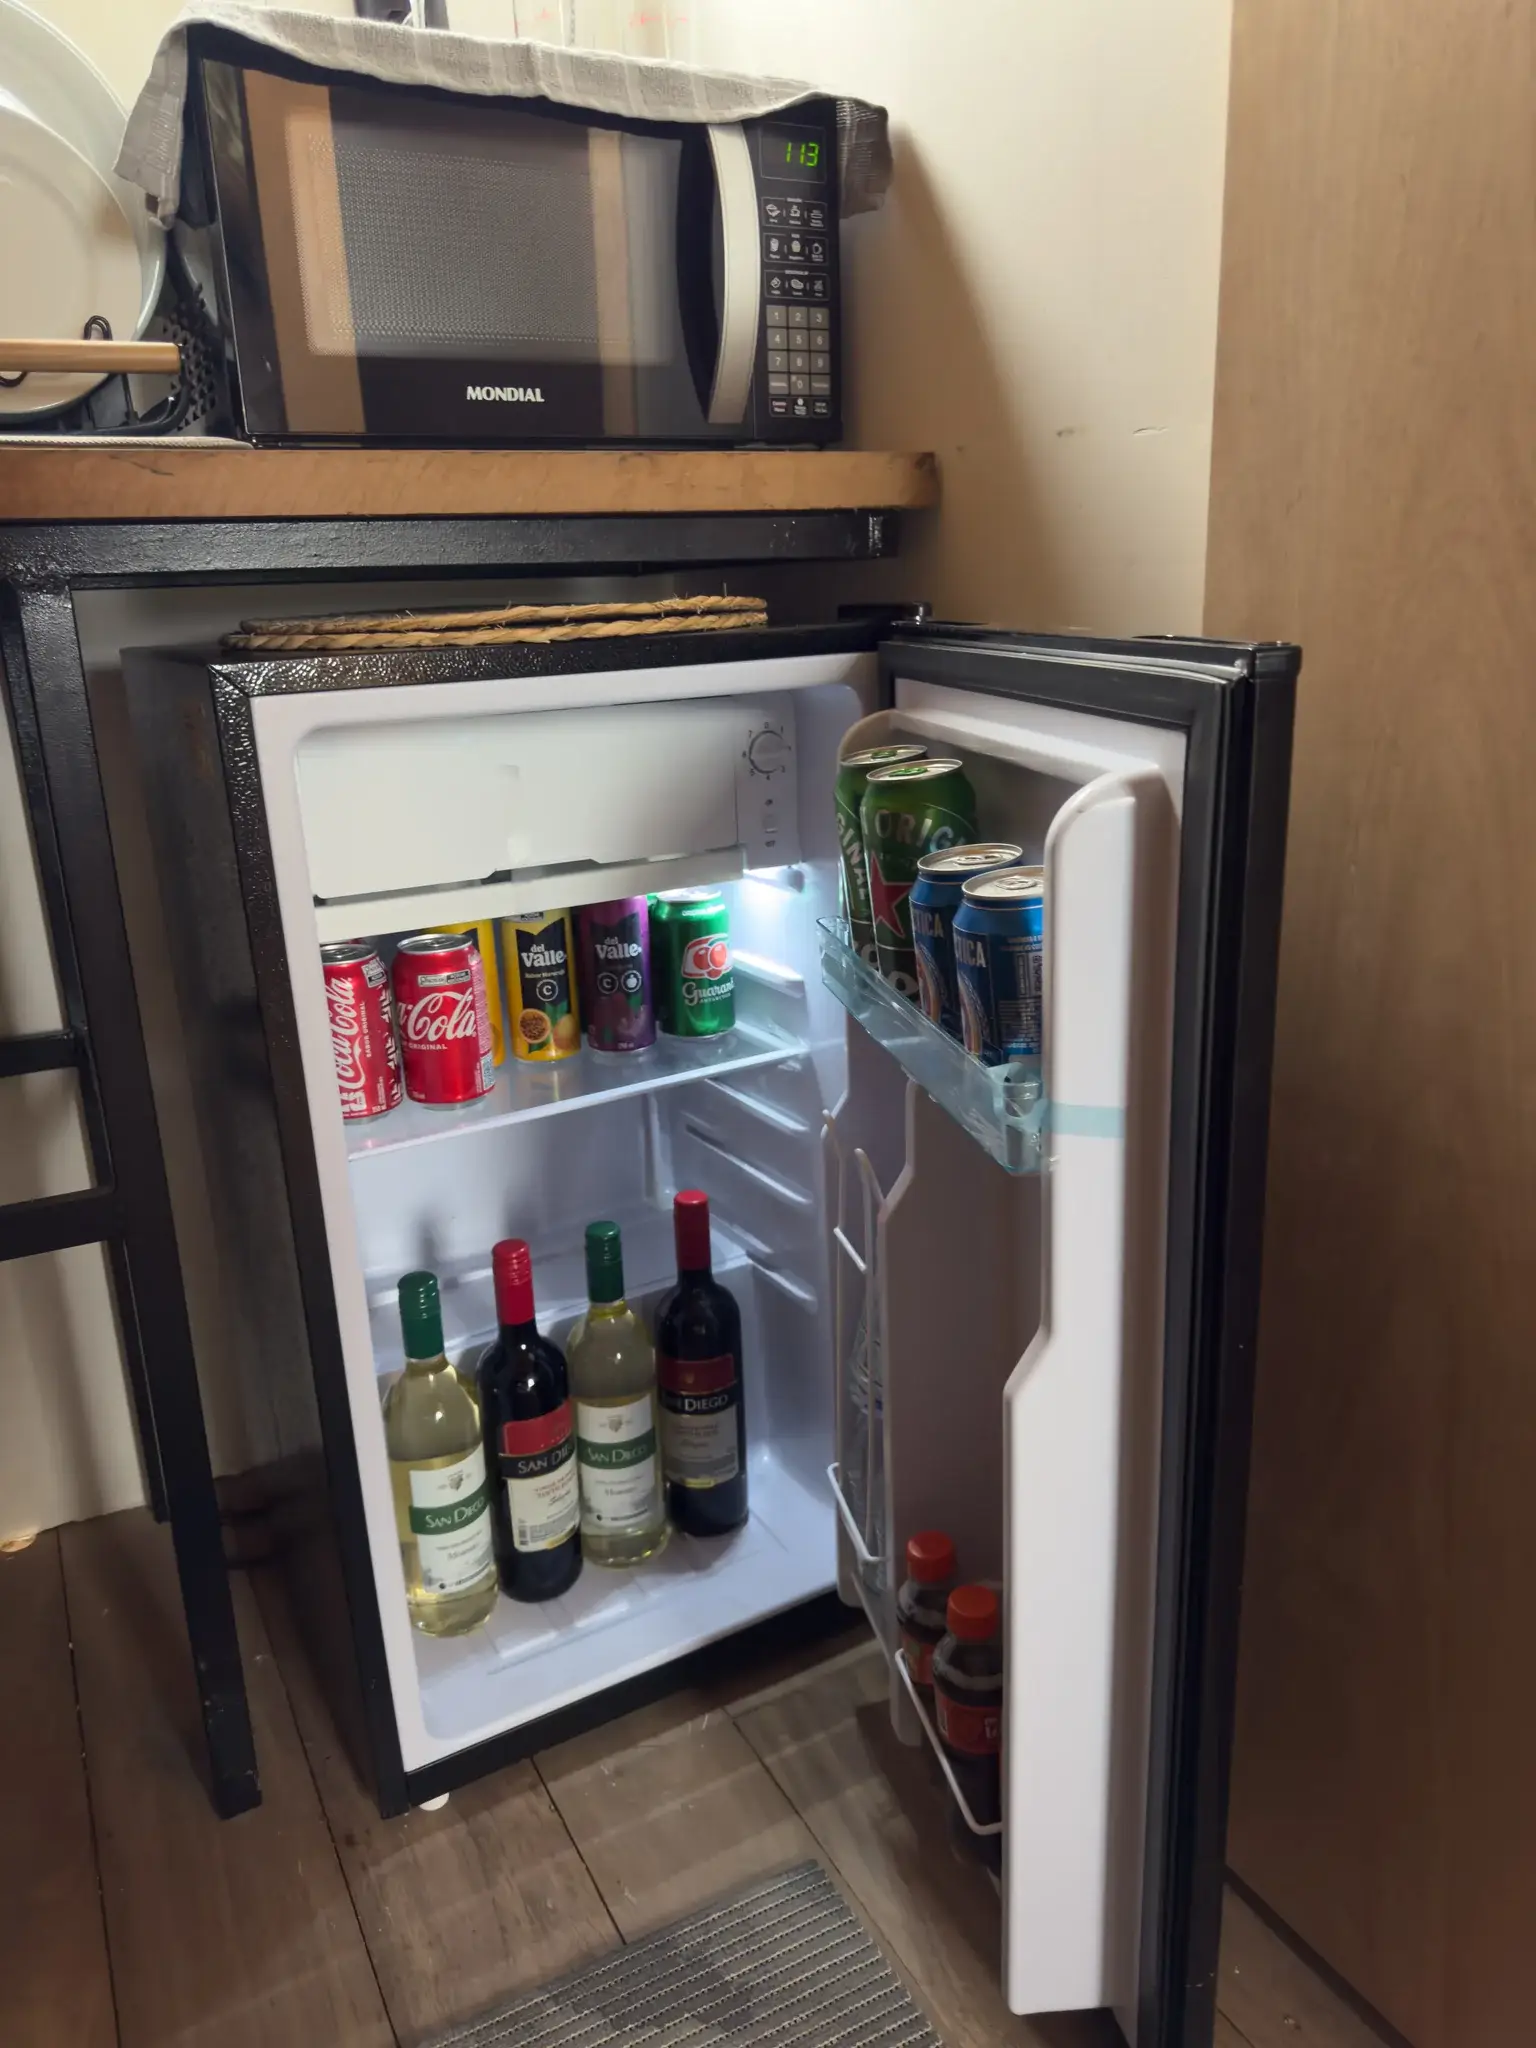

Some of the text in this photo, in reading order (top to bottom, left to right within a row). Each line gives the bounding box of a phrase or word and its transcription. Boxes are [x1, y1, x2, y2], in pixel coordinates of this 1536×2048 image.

[466, 386, 545, 403] MONDIAL
[530, 944, 545, 953] del
[604, 937, 619, 945] del
[521, 950, 567, 968] Valle
[595, 943, 642, 960] Valle
[408, 1042, 448, 1050] ORIGINAL
[684, 1393, 730, 1412] DIEGO
[517, 1456, 549, 1475] SAN
[425, 1514, 452, 1528] SAN
